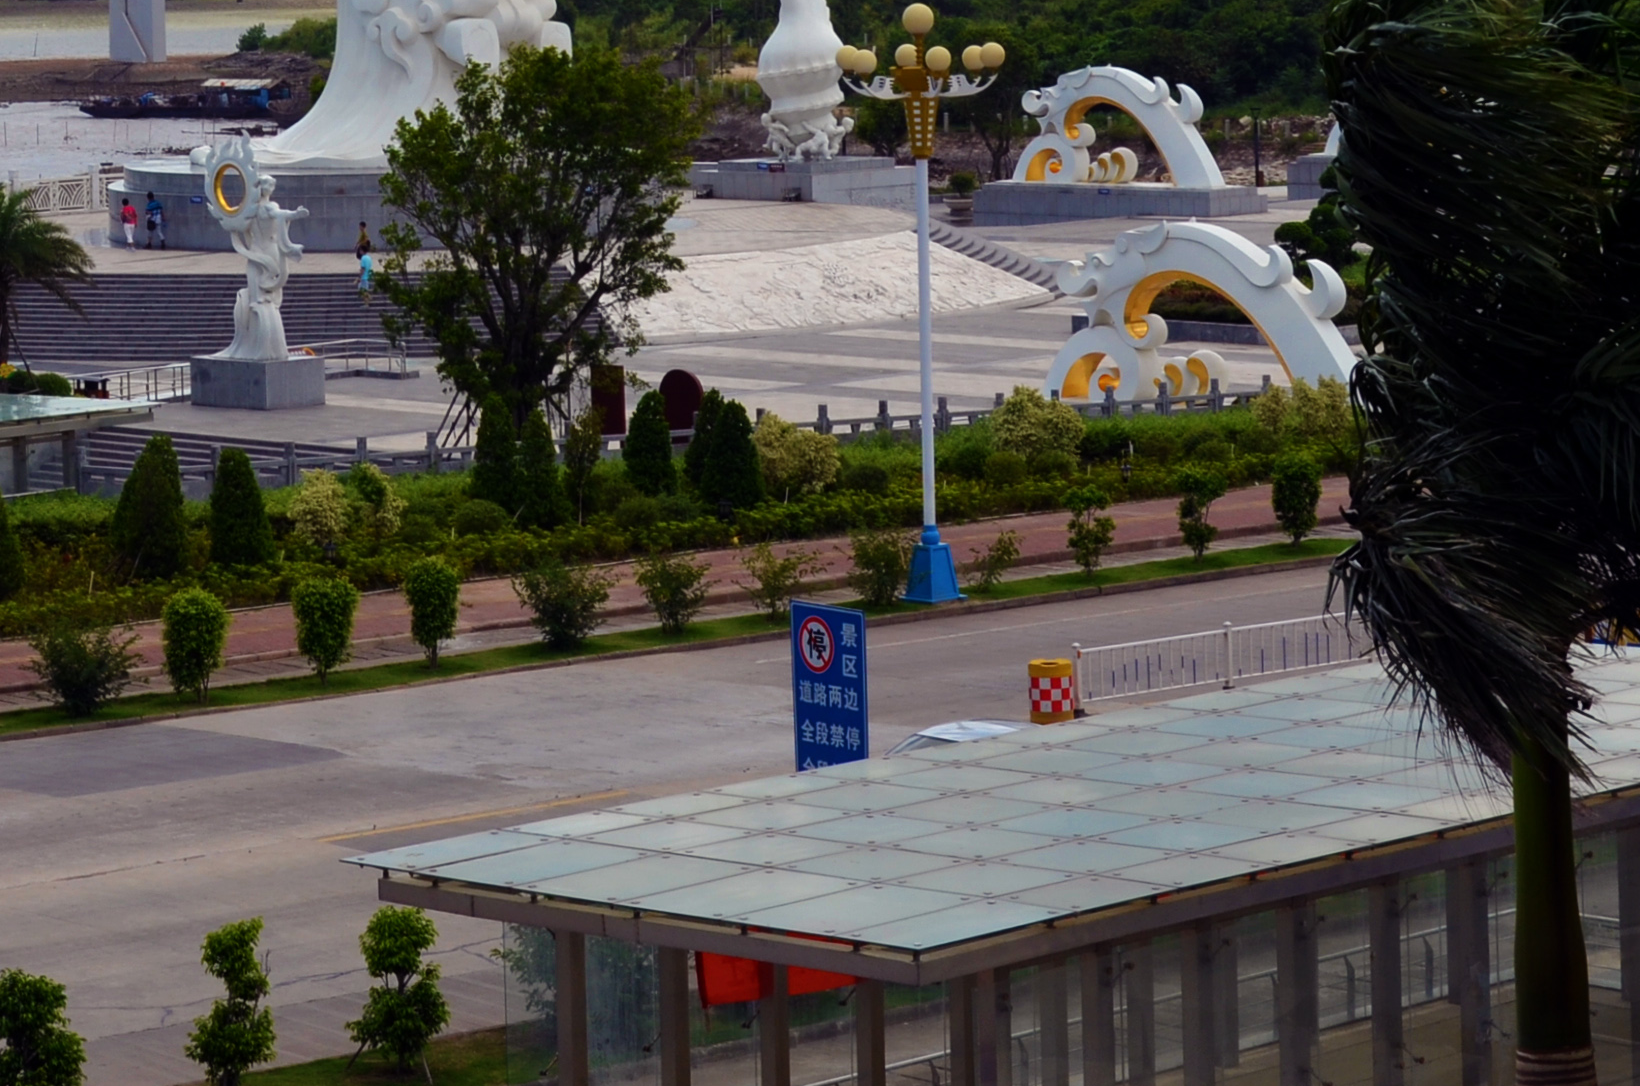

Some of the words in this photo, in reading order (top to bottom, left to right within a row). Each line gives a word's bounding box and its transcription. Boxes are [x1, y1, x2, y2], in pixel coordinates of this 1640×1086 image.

[840, 622, 858, 678] 景区
[799, 679, 859, 711] 道路两边
[801, 718, 860, 751] 全段禁停
